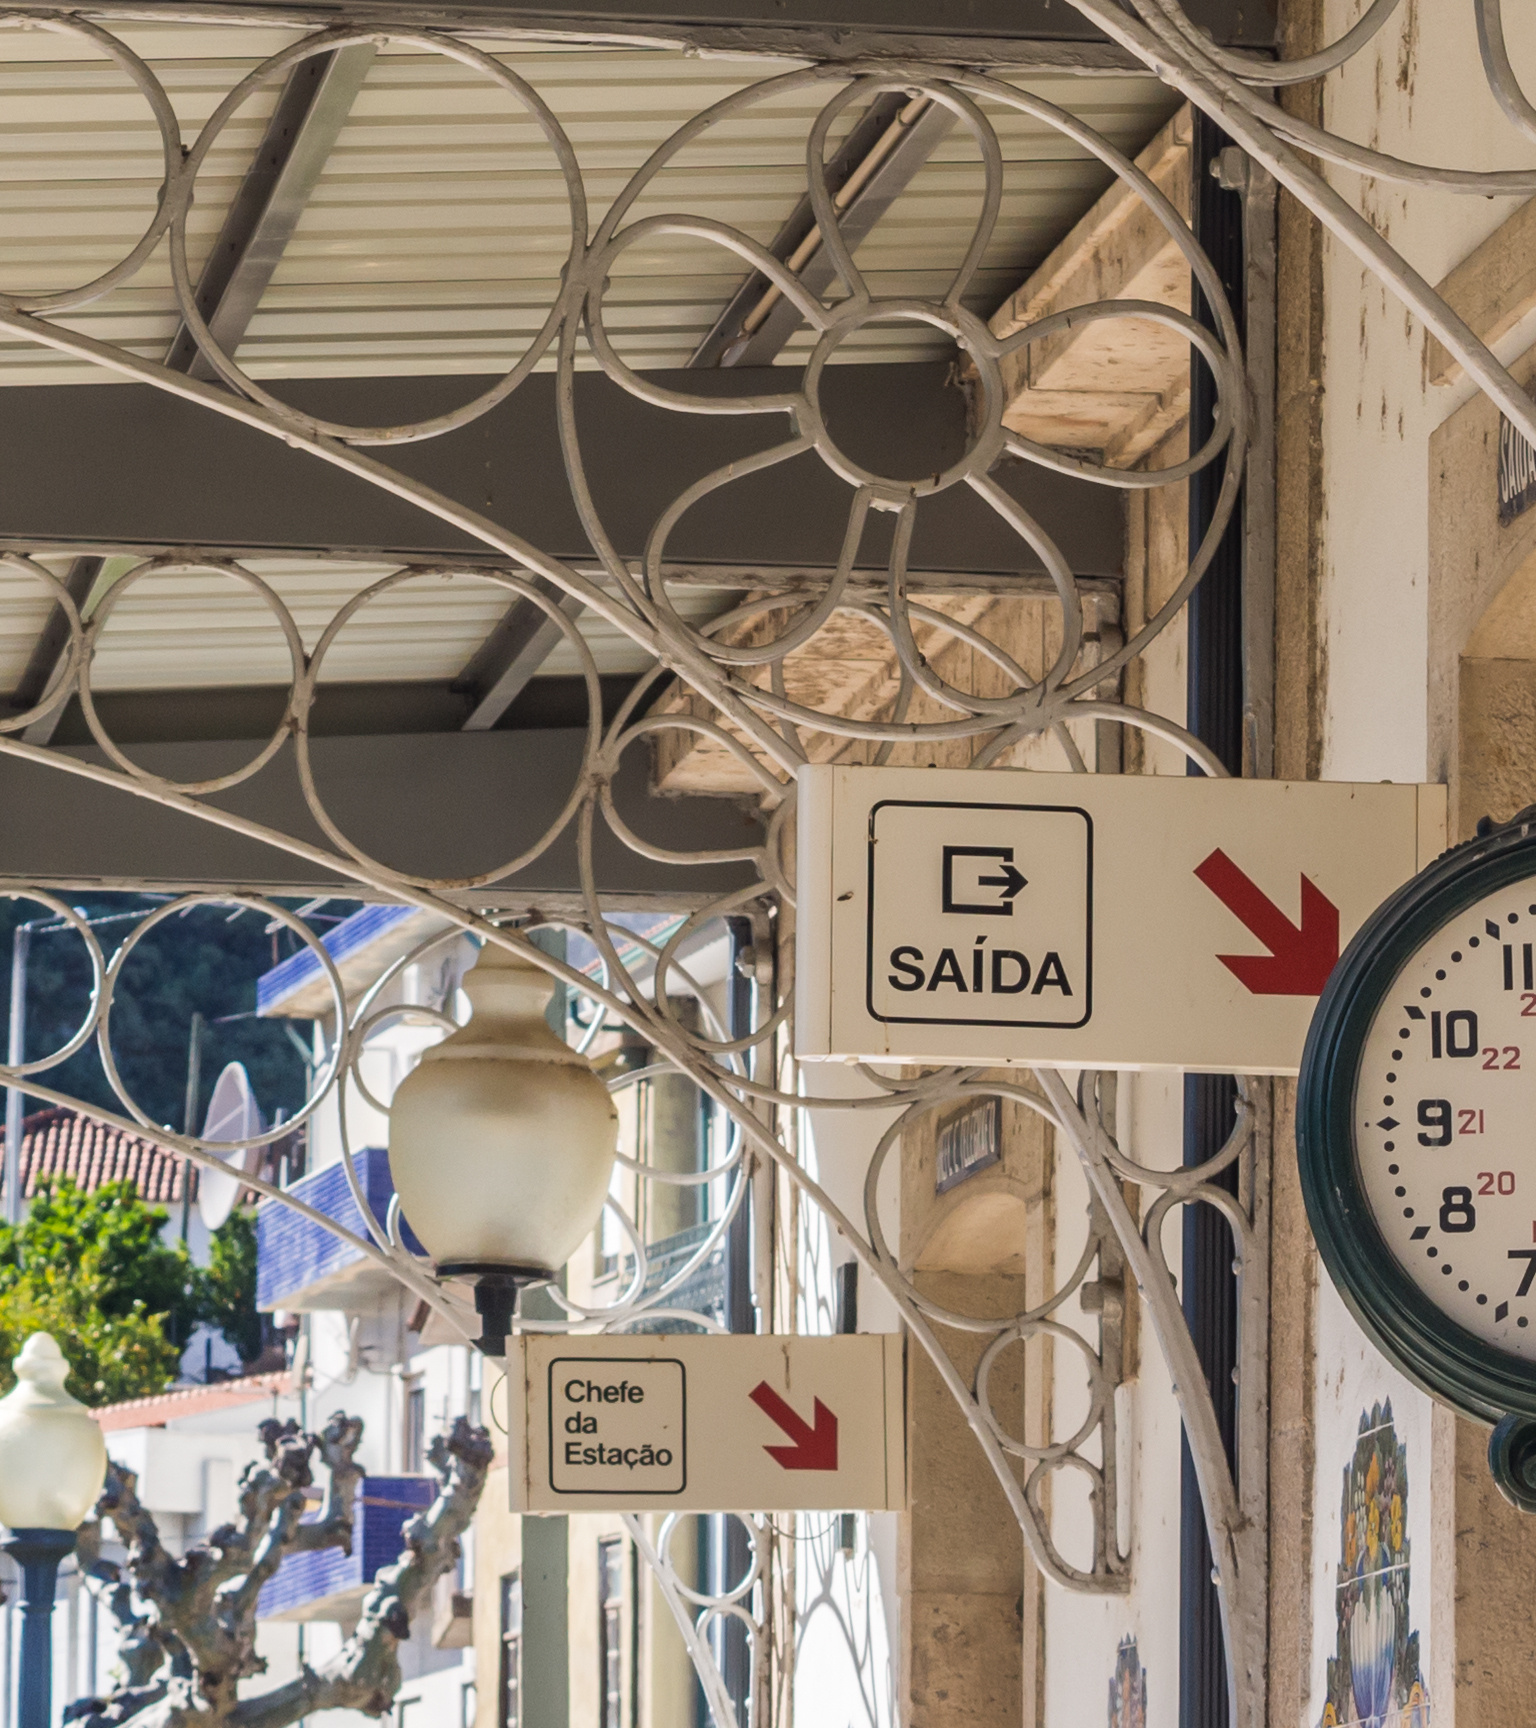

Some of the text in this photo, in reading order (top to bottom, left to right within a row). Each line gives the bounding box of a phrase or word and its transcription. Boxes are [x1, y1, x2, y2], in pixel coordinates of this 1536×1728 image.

[889, 936, 1073, 996] SAÍDA
[1503, 943, 1533, 990] 11
[1431, 1010, 1478, 1058] 10
[1482, 1047, 1520, 1070] 22
[1417, 1100, 1452, 1146] 9
[1458, 1110, 1484, 1134] 21
[1477, 1171, 1515, 1195] 20
[1440, 1187, 1475, 1233] 8
[565, 1380, 644, 1403] Chefe
[565, 1411, 597, 1434] da
[565, 1442, 672, 1469] Estação
